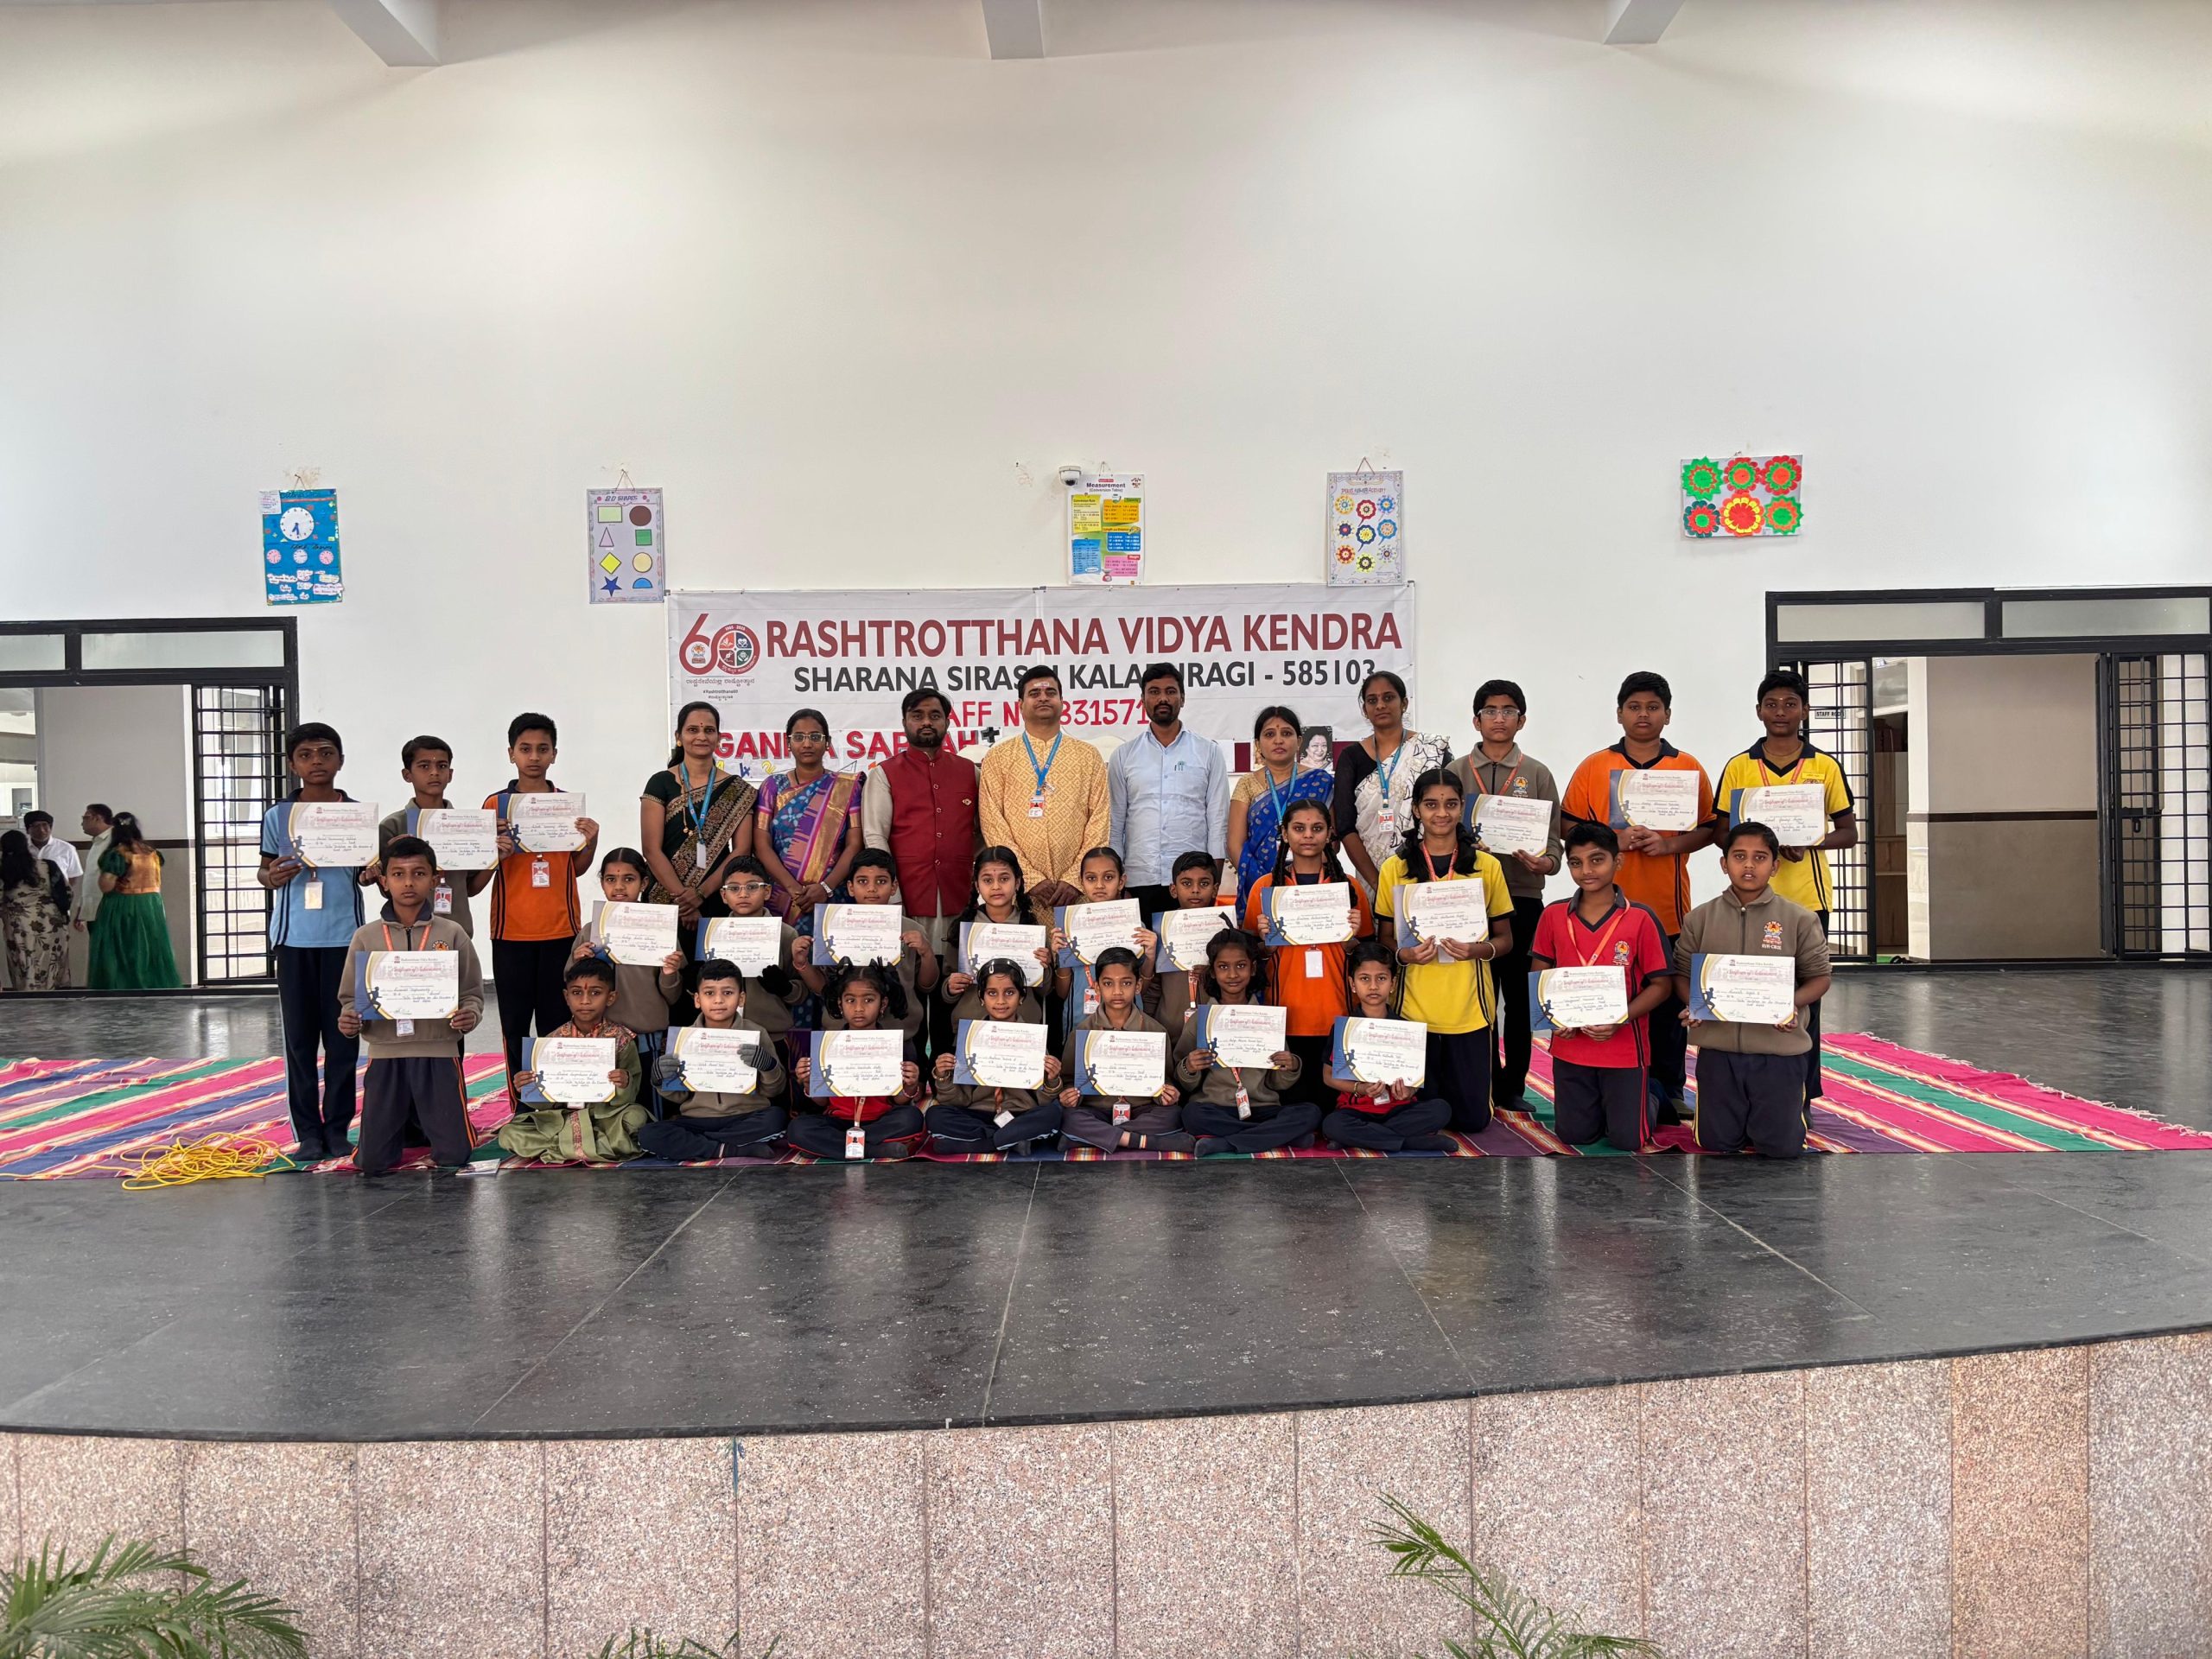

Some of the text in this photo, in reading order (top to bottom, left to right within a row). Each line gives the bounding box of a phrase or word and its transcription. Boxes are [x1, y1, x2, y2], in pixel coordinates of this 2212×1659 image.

[766, 612, 1402, 658] RASHTROTTHANA VIDYA KENDRA
[794, 667, 939, 692] SHARANA
[947, 664, 1058, 691] SIRASI
[1069, 661, 1255, 690] KALARAGI
[1003, 701, 1020, 727] N
